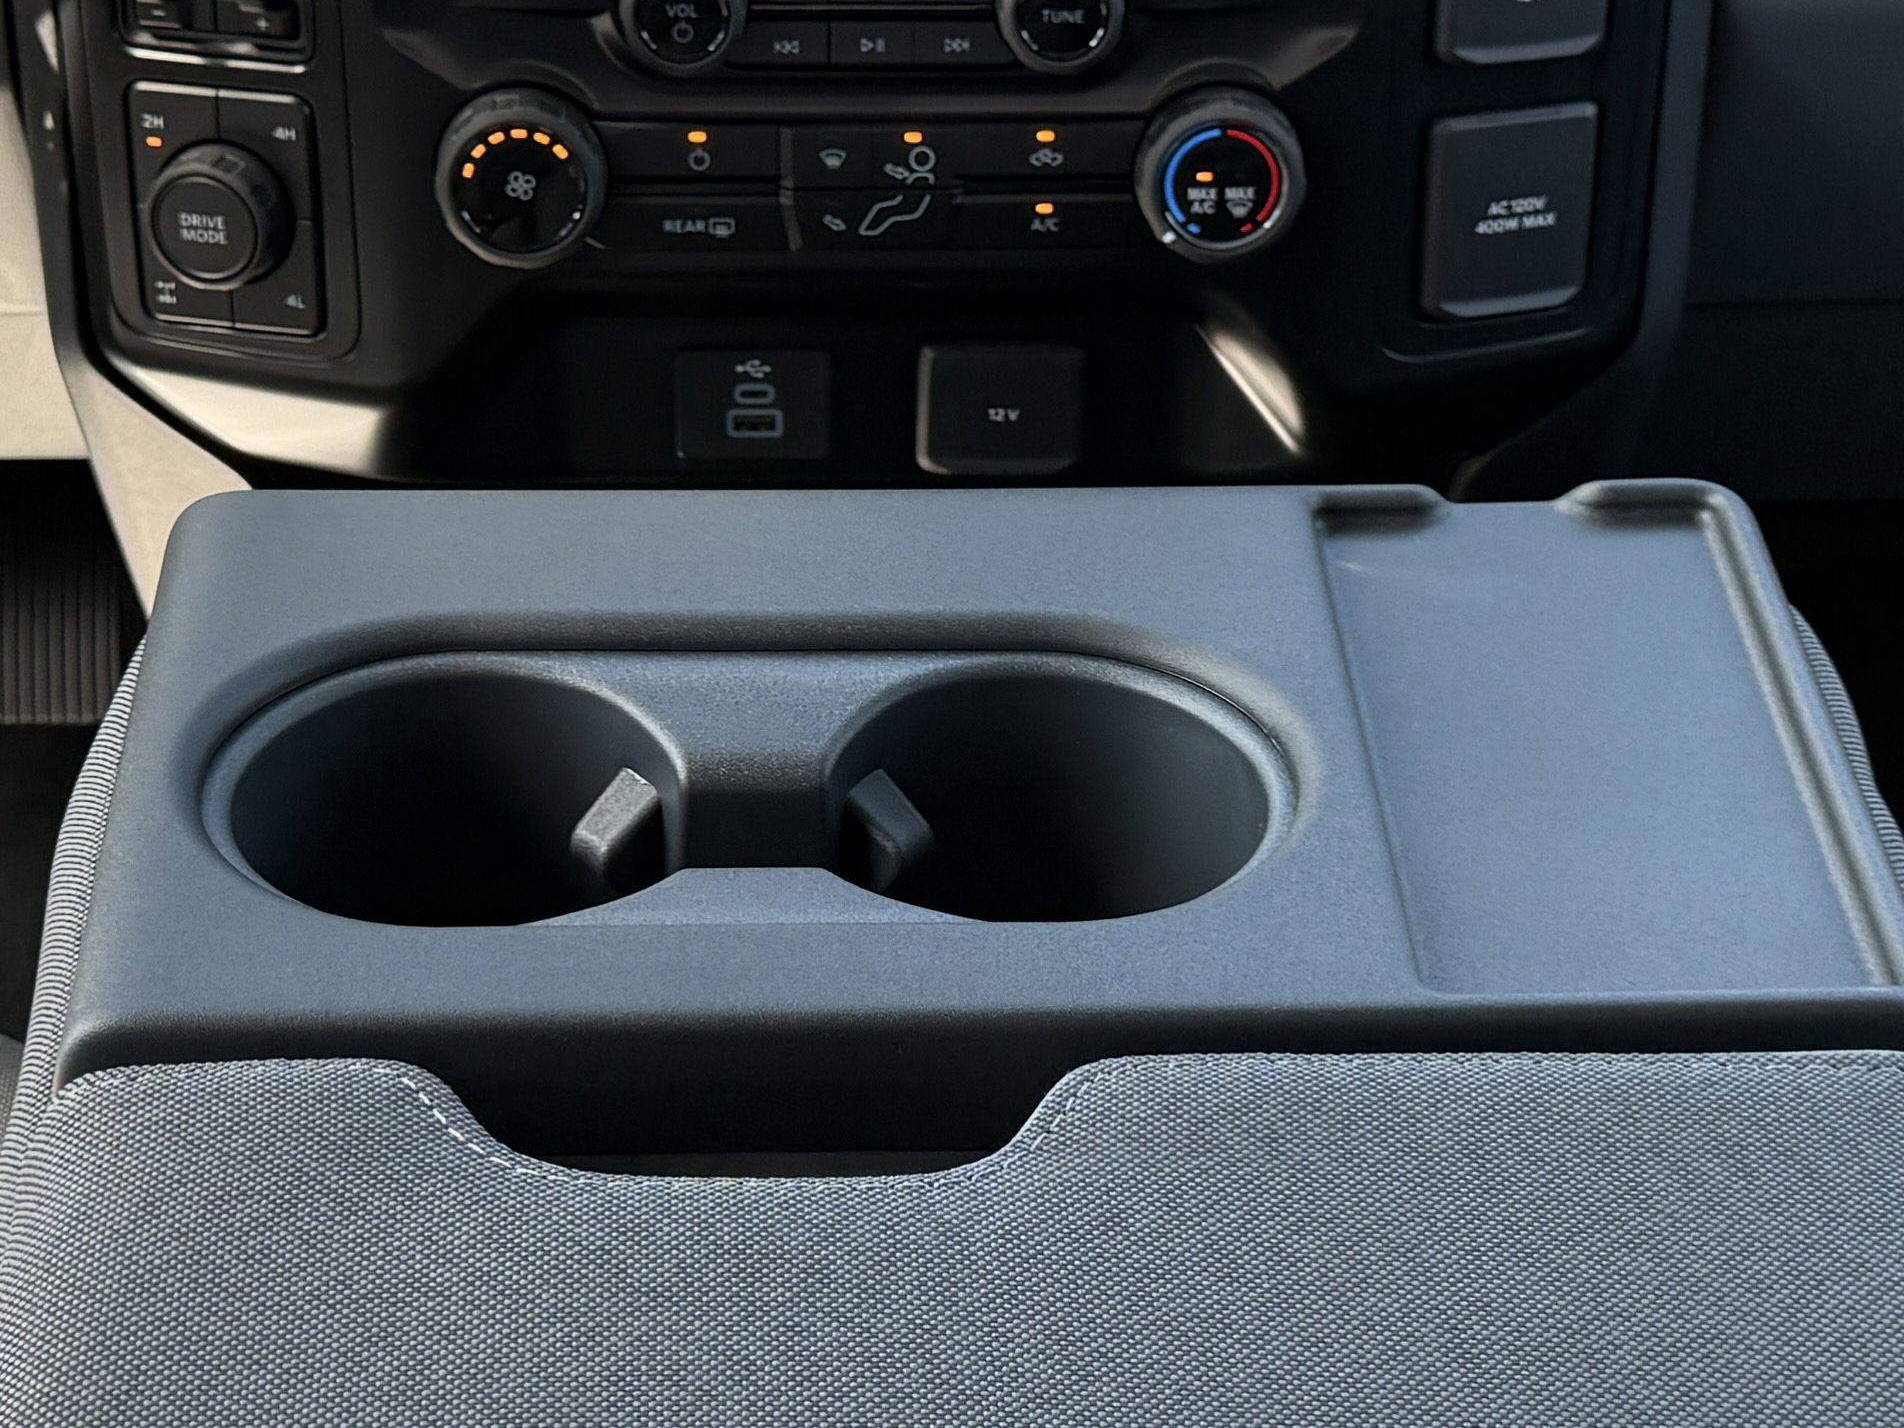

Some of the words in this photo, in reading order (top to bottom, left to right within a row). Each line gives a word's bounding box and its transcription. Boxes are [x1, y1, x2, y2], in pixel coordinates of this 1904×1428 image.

[666, 3, 697, 19] VOL
[1041, 9, 1085, 25] TUNE
[140, 113, 164, 130] 2H
[272, 125, 297, 141] 4H
[1187, 186, 1218, 200] MAX
[1225, 185, 1256, 200] MAX
[177, 212, 227, 230] DRIVE
[663, 219, 706, 233] REAR
[1030, 217, 1059, 232] A/C
[1522, 211, 1558, 230] MAX
[180, 228, 229, 245] MODE
